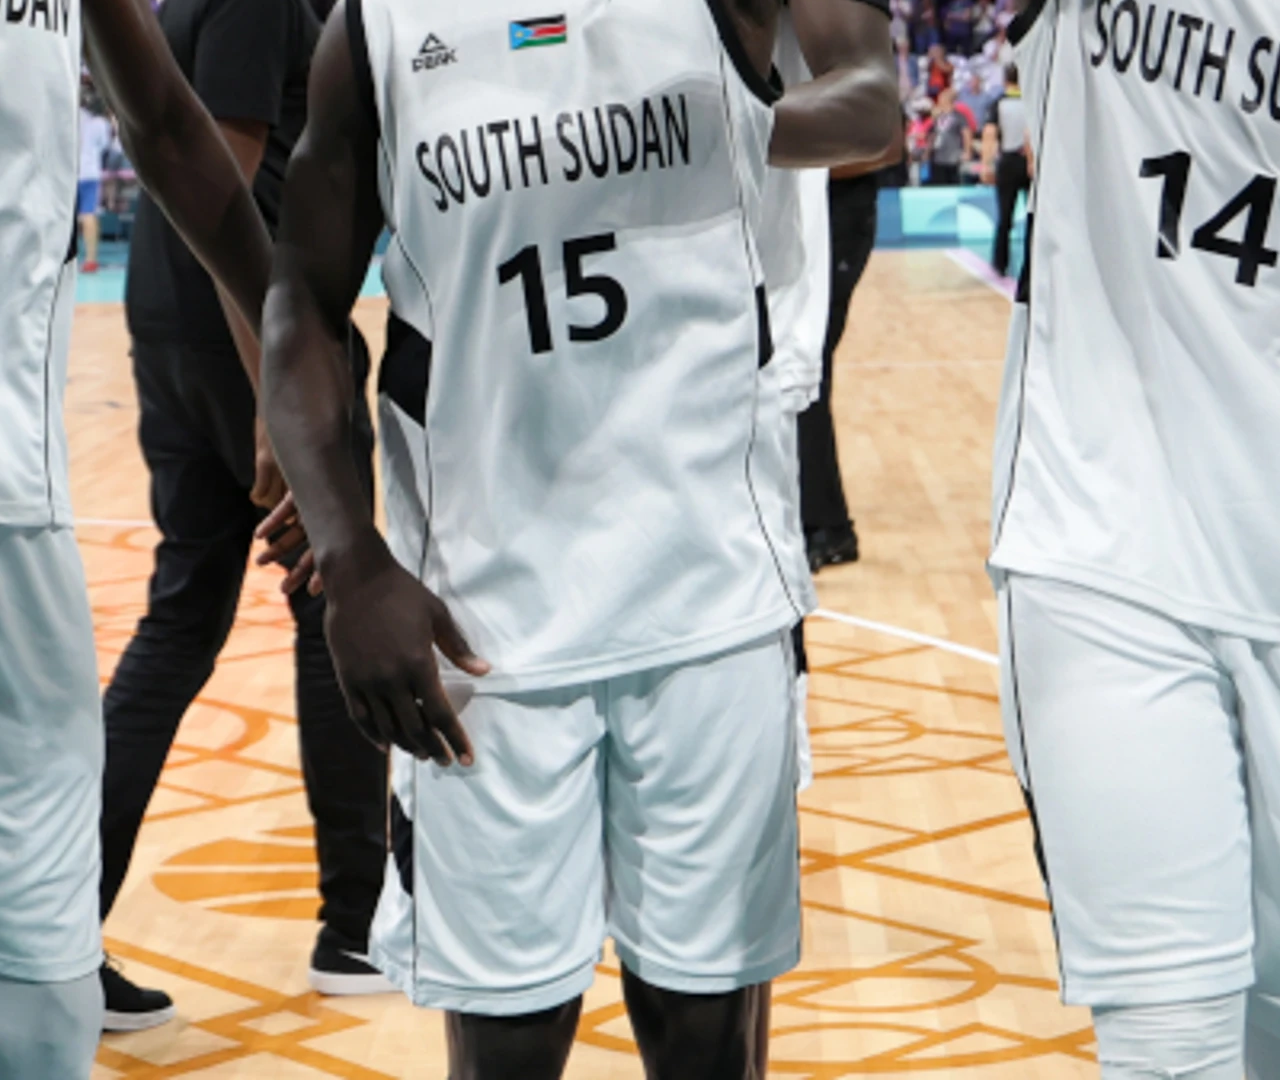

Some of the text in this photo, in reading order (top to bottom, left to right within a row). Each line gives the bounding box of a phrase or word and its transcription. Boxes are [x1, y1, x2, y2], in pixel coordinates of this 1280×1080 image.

[415, 94, 690, 213] SOUTH SUDAN
[1139, 151, 1279, 287] 14
[497, 231, 628, 354] 15
